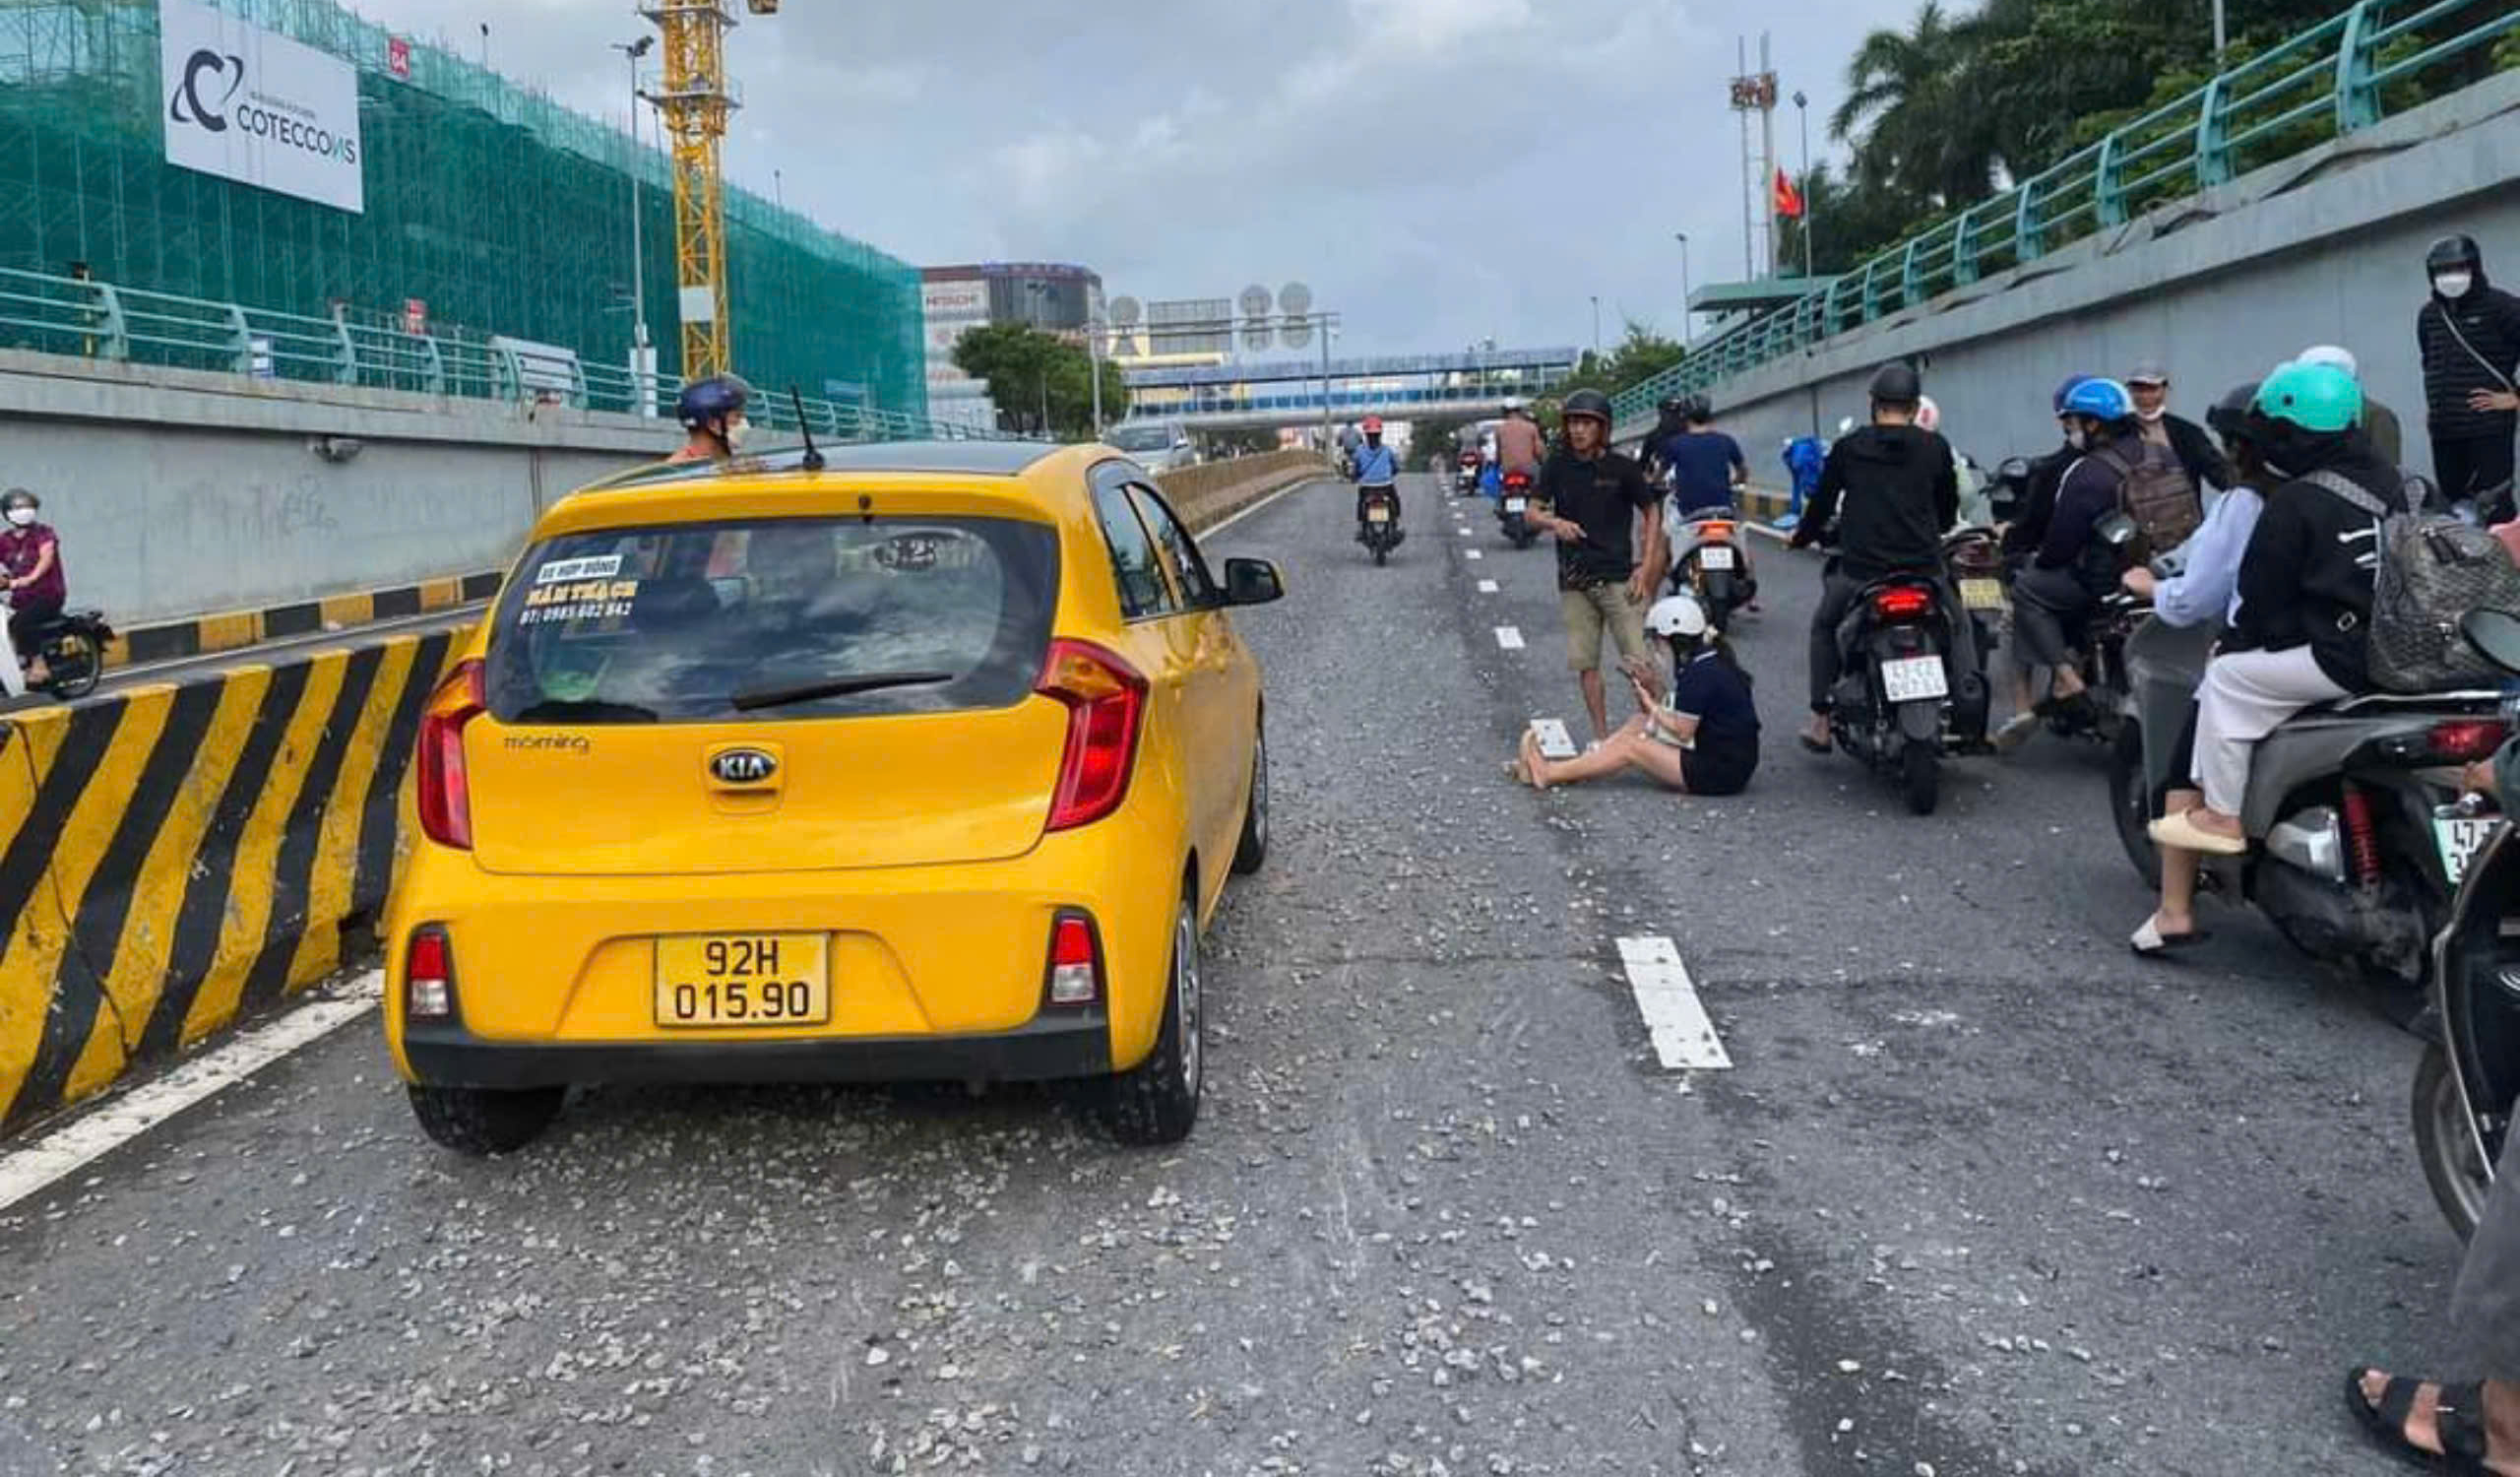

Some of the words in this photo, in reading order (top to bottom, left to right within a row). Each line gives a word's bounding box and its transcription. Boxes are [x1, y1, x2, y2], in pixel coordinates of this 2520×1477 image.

[237, 104, 355, 164] COTECCONS
[720, 757, 766, 778] KIA
[706, 940, 779, 976] 92H
[675, 982, 809, 1019] 015.90
